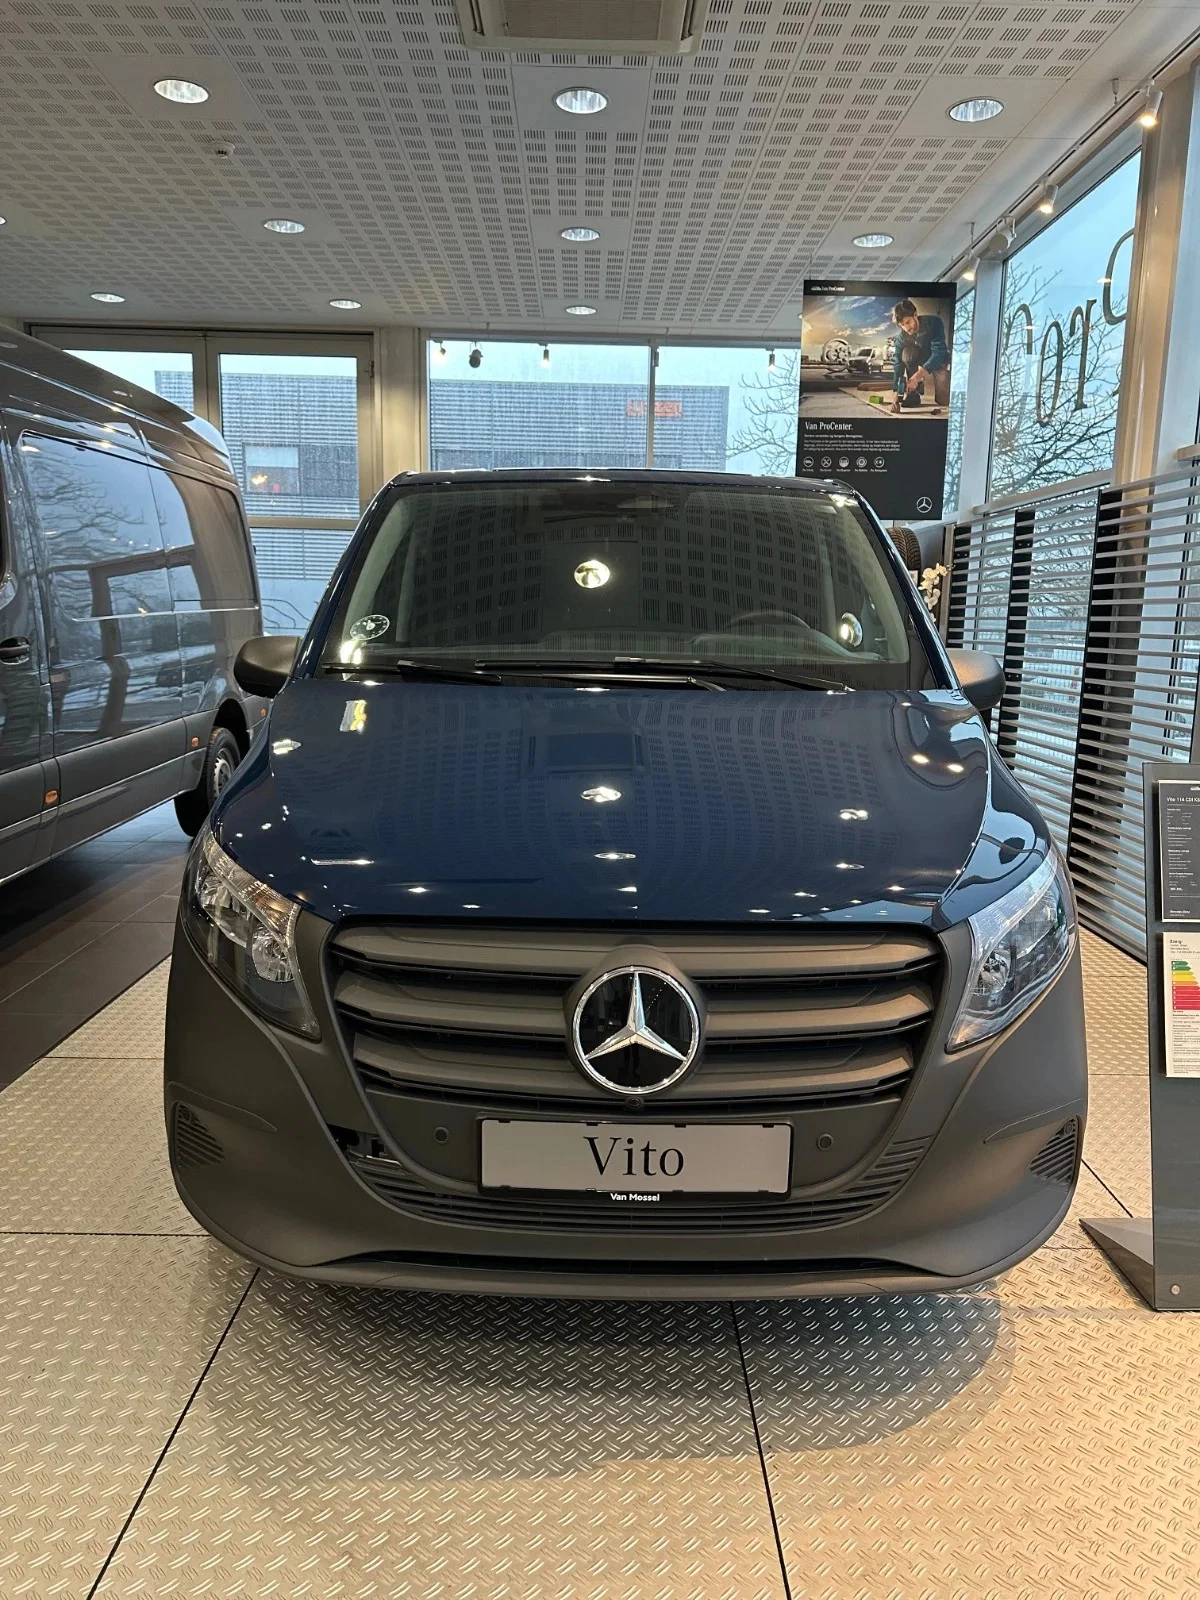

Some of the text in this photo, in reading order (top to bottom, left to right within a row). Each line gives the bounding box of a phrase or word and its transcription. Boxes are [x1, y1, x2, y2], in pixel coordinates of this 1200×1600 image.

[805, 421, 854, 431] Van ProCenter.
[583, 1136, 684, 1177] Vito
[610, 1193, 660, 1202] Van Mossel
